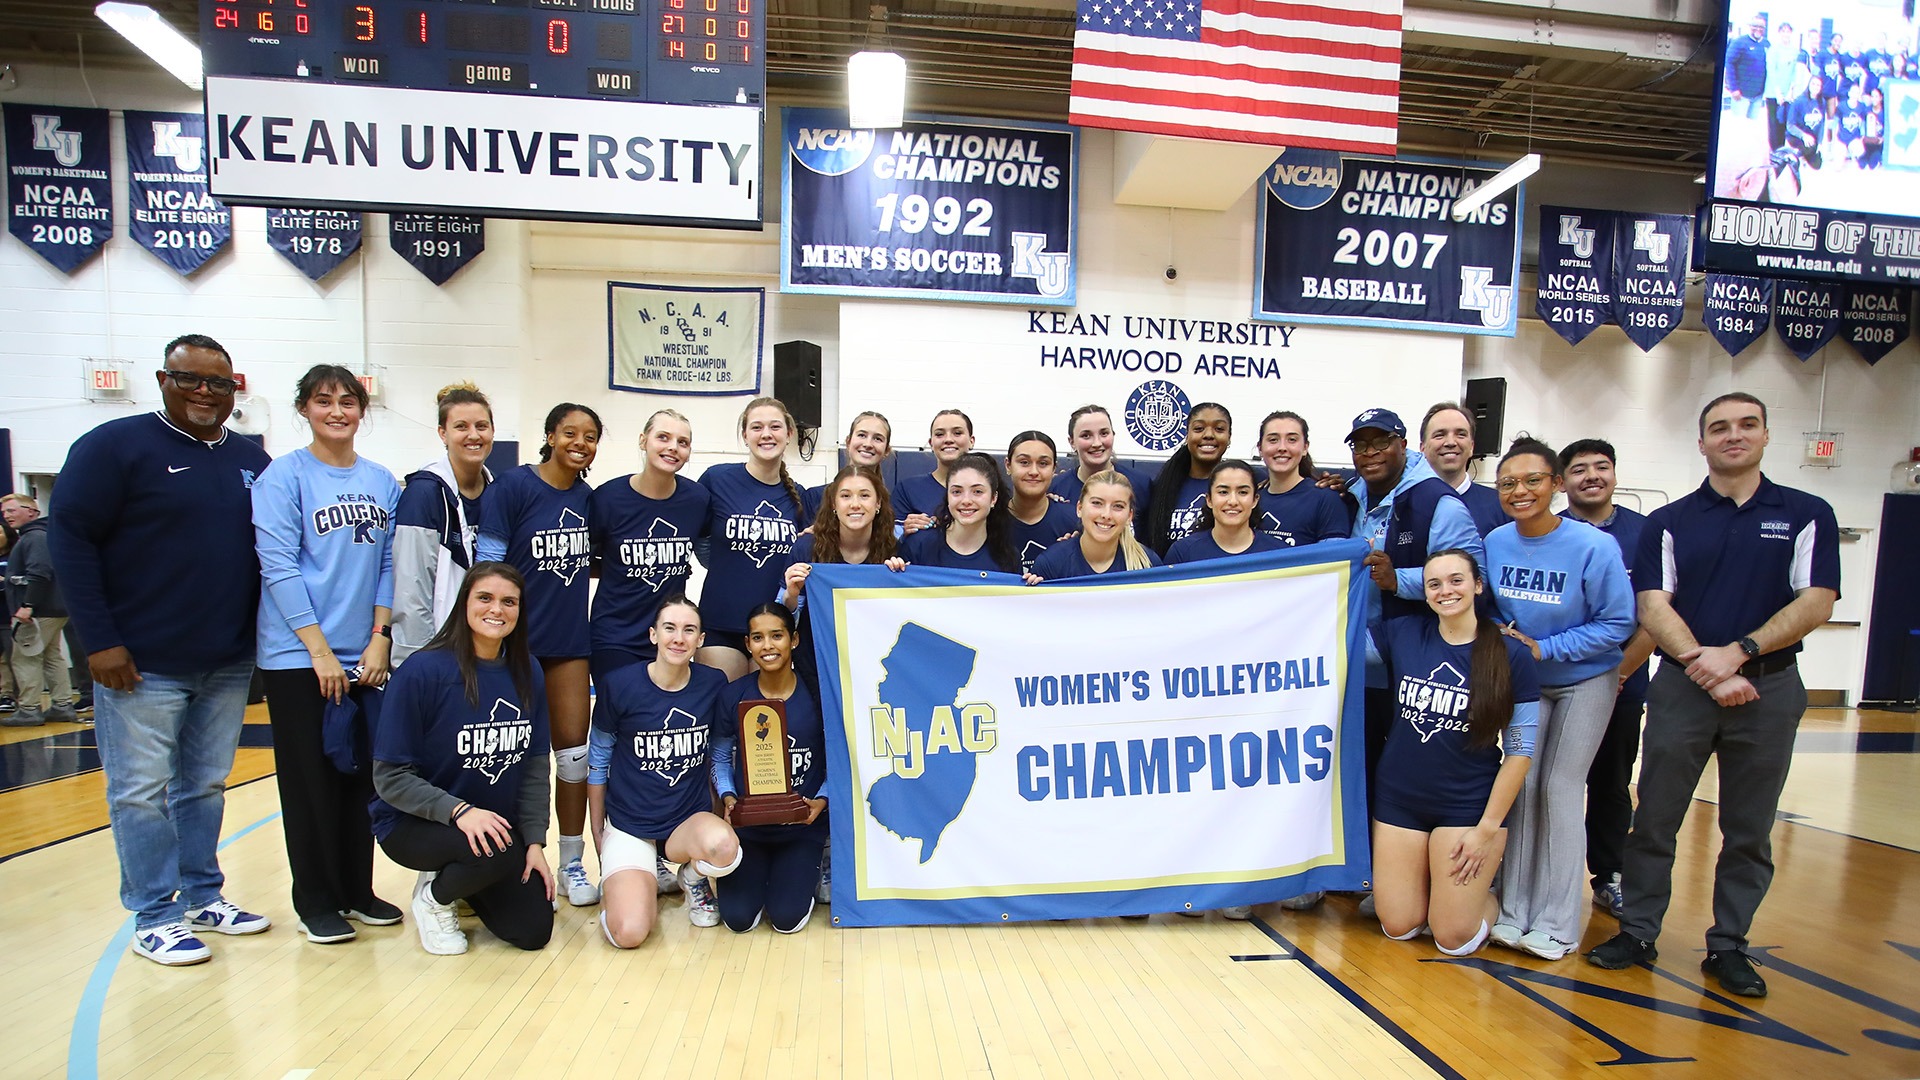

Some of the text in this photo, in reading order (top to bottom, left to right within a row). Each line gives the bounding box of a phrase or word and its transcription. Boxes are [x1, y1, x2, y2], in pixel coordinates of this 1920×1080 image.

[215, 7, 309, 33] 24 16 0
[355, 6, 374, 41] 3
[420, 12, 427, 42] 1
[663, 14, 749, 38] 27 0 0
[548, 19, 568, 54] 0
[669, 41, 749, 62] 14 0 1
[343, 57, 380, 75] won
[466, 64, 511, 85] game
[596, 74, 632, 90] won
[31, 115, 82, 167] KU
[796, 128, 871, 151] NCAA
[889, 131, 1044, 163] NATIONAL
[217, 114, 752, 186] KEAN UNIVERSITY
[12, 166, 108, 180] WOMEN'S BASKETBALL
[873, 155, 1061, 189] CHAMPIONS
[1272, 163, 1338, 189] NCAA
[1356, 169, 1488, 198] NATIONA
[24, 184, 96, 206] NCAA
[146, 190, 216, 211] NCAA
[15, 205, 109, 221] ELITE EIGHT
[136, 209, 229, 225] ELITE EIGHT
[875, 193, 993, 237] 1992
[271, 217, 359, 231] ELITE EIGHT
[394, 221, 481, 234] ELITE EIGHT
[1710, 203, 1819, 251] HOME
[1825, 220, 1866, 254] OF
[32, 224, 93, 245] 2008
[154, 230, 213, 249] 2010
[1558, 215, 1595, 259] KU
[1633, 220, 1670, 264] KU
[289, 237, 342, 255] 1978
[412, 240, 462, 257] 1991
[1333, 227, 1448, 269] 2007
[801, 245, 1003, 276] MEN'S SOCCER
[1011, 232, 1070, 297] KU
[1559, 259, 1592, 268] SOFTBALL
[1636, 263, 1668, 273] SOFTBALL
[1757, 254, 1862, 275] www.kean.edu
[1301, 276, 1426, 305] BASEBALL
[1548, 273, 1600, 293] NCAA
[1626, 278, 1677, 296] NCAA
[1712, 282, 1761, 302] NCAA
[1459, 266, 1513, 329] KU
[1538, 289, 1610, 304] WORLD SERIES
[1619, 295, 1683, 307] WORLD SERIES
[1707, 298, 1768, 314] FINAL FOUR
[1783, 289, 1831, 307] NCAA
[1851, 294, 1899, 311] NCAA
[1551, 307, 1595, 324] 2015
[1628, 312, 1669, 329] 1986
[1776, 305, 1839, 319] FINAL FOUR
[1844, 311, 1907, 323] WORLD SERIES
[660, 325, 712, 337] 19 91
[1027, 311, 1297, 347] KEAN UNIVERSITY
[1715, 316, 1754, 334] 1984
[1786, 322, 1824, 339] 1987
[1853, 327, 1895, 343] 2008
[663, 343, 709, 356] WRESTLING
[644, 356, 727, 369] NATIONAL CHAMPION
[1041, 345, 1281, 380] HARWOOD ARENA
[95, 371, 118, 389] EXIT
[637, 368, 662, 381] FRANK
[716, 371, 733, 382] LBS.
[1138, 381, 1181, 398] KEAN
[1125, 410, 1190, 451] UNIVERSITY
[1816, 441, 1835, 456] EXIT
[336, 493, 377, 504] KEAN
[1499, 564, 1568, 595] KEAN
[1498, 587, 1562, 605] VOLLEYBALL
[1014, 656, 1331, 708] WOMEN'S VOLLEYBALL
[755, 743, 773, 751] 2025
[870, 703, 997, 780] NJAC
[1016, 723, 1334, 802] CHAMPIONS
